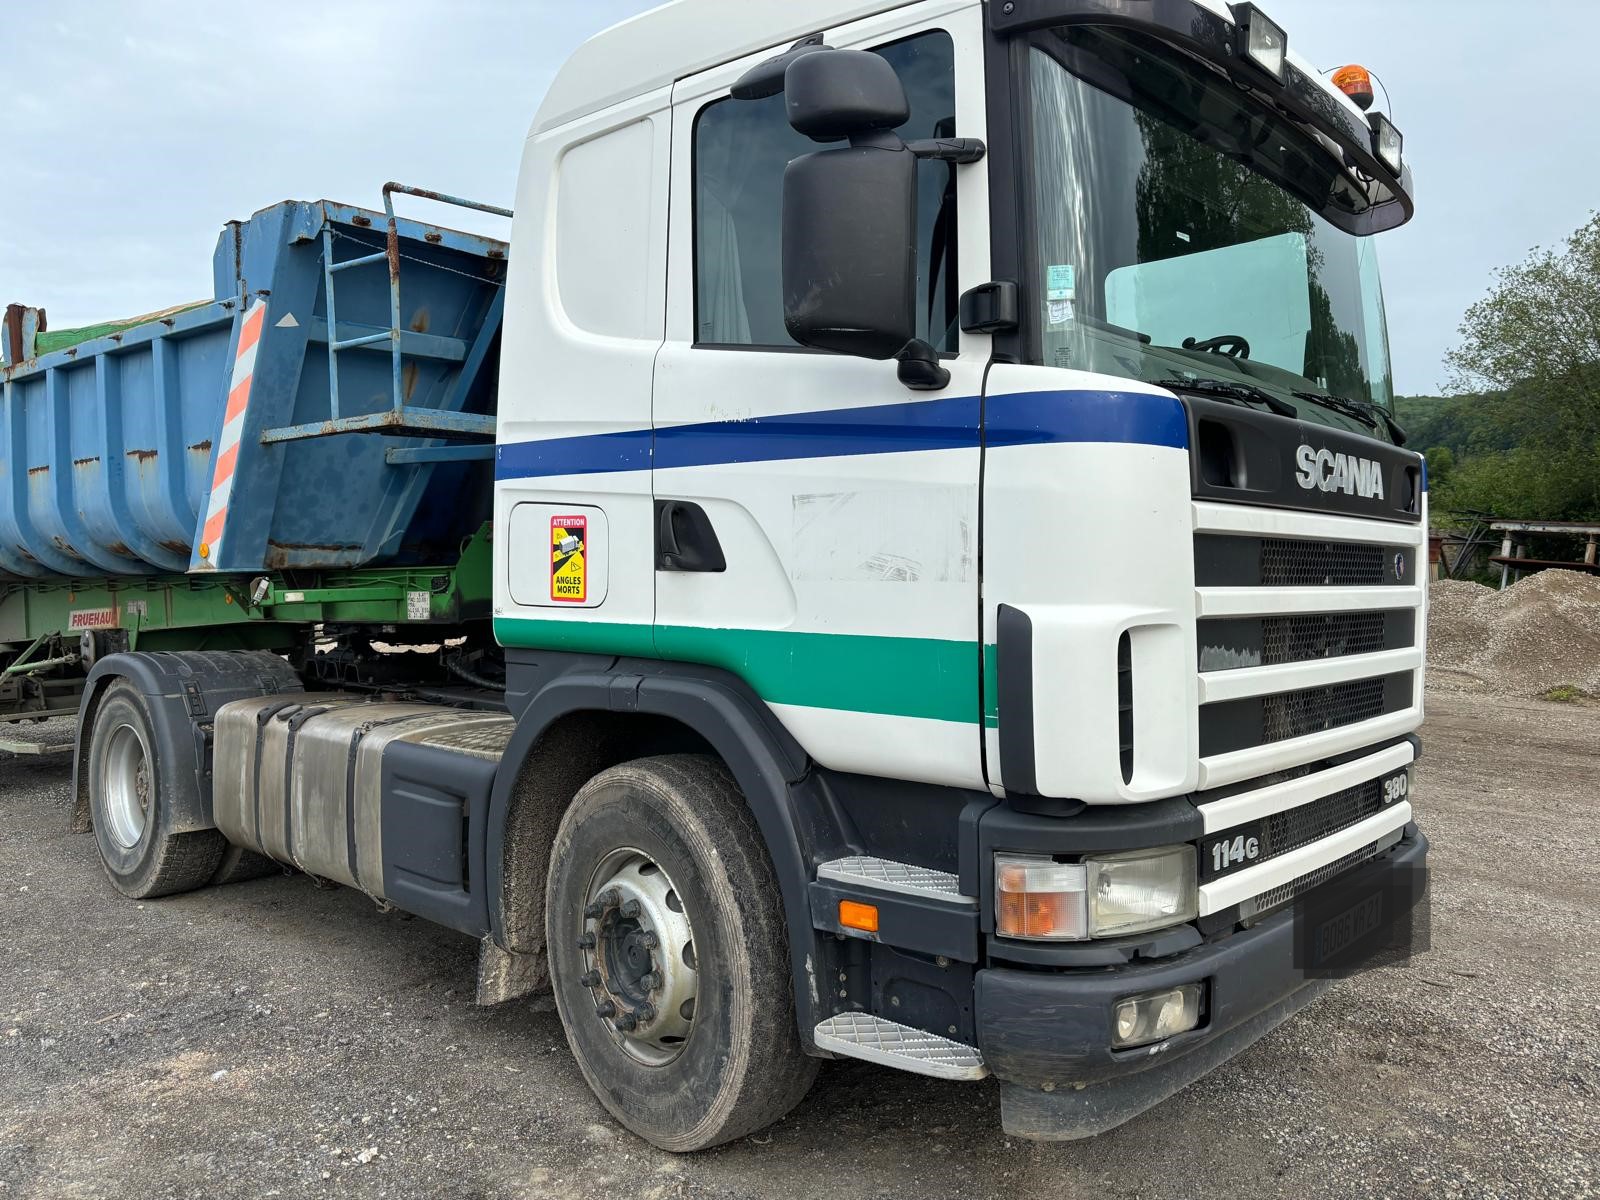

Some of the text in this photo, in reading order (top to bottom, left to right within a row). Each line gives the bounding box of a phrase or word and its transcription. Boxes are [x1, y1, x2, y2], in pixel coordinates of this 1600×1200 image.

[1295, 444, 1384, 500] SCANIA
[553, 518, 585, 527] ATTENTION
[556, 576, 581, 585] ANGLES
[557, 585, 580, 594] MORTS
[1384, 774, 1408, 804] 380
[1212, 835, 1259, 871] 114G
